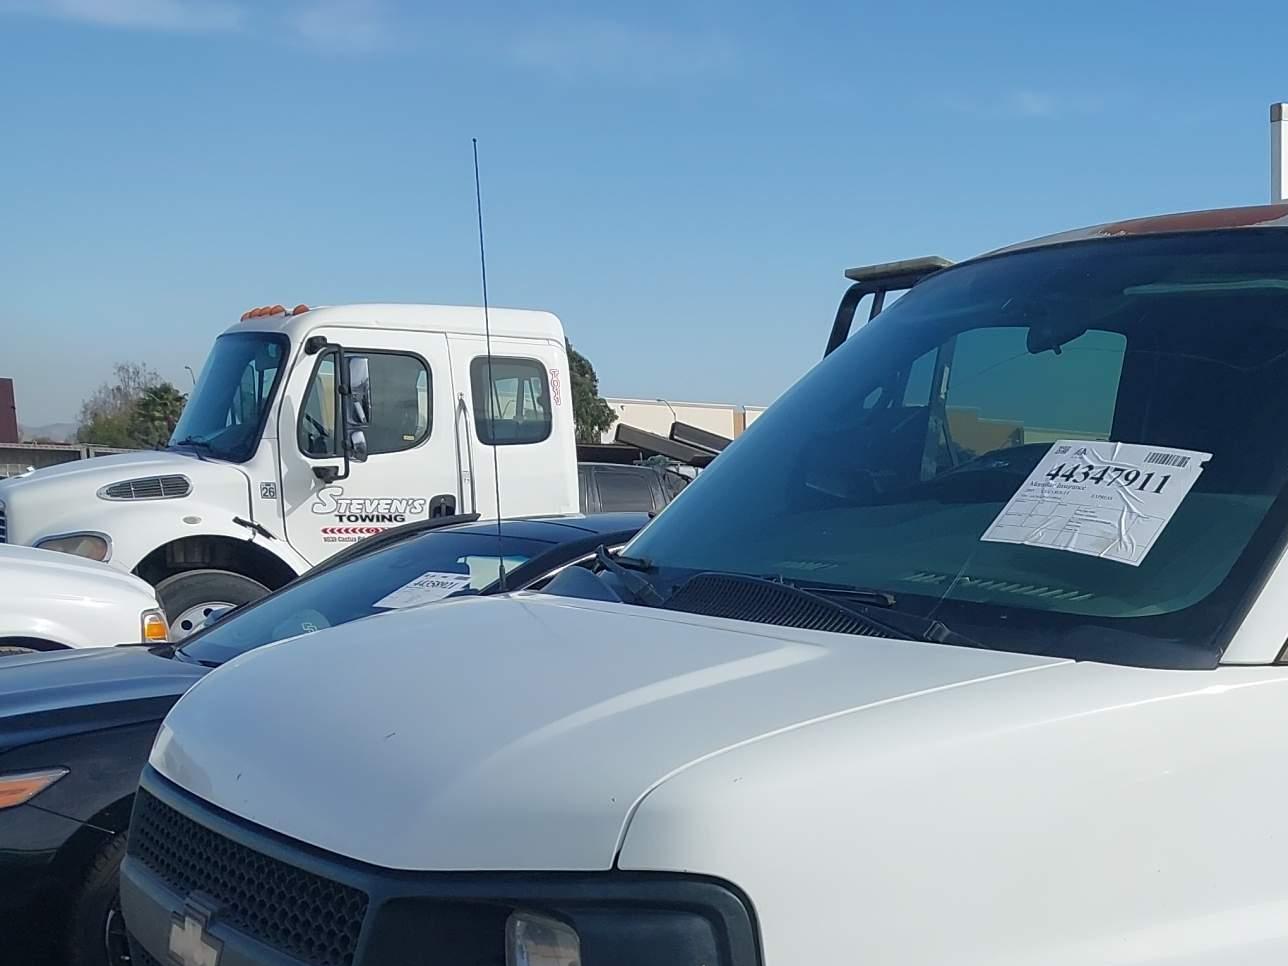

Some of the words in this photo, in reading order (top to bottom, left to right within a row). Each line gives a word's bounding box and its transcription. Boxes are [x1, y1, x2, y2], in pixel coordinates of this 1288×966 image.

[1046, 462, 1172, 494] 44347911
[262, 486, 275, 497] 26
[334, 514, 406, 523] TOWING
